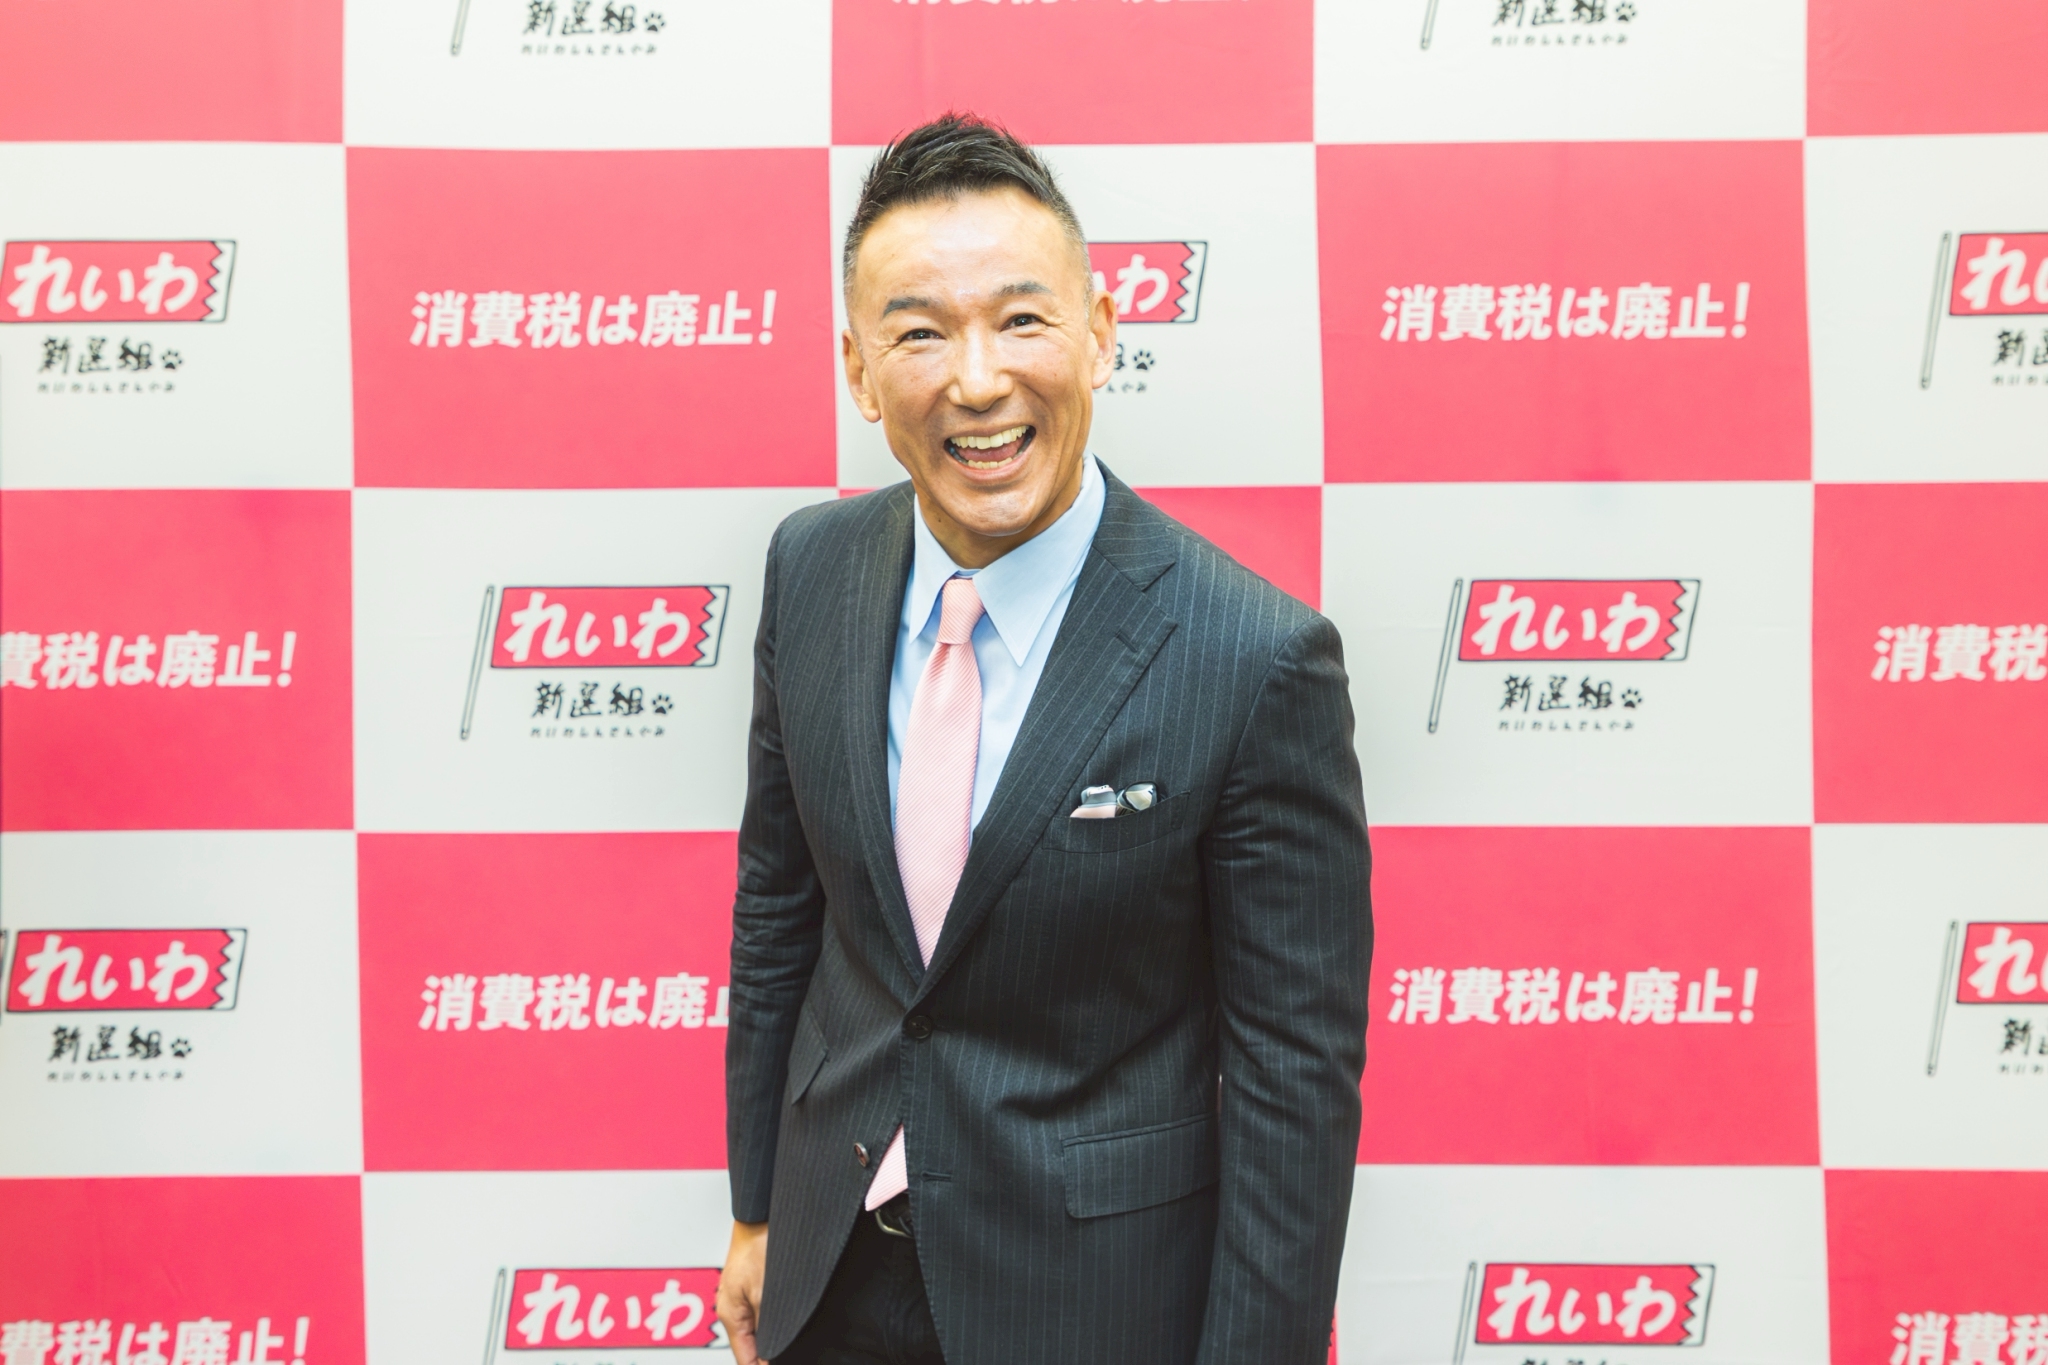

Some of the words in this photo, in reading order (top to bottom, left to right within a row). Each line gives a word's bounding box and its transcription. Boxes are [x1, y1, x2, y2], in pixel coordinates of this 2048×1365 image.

[7, 245, 198, 318] れいわ
[1380, 282, 1750, 342] 消費税は廃止!
[410, 289, 777, 349] 消費税は廃止!
[502, 591, 690, 664] れいわ
[1470, 585, 1661, 655] れいわ
[1871, 623, 2048, 682] 消費税
[17, 934, 209, 1006] れいわ
[1388, 966, 1758, 1025] 消費税は廃止!
[516, 1272, 705, 1345] れいわ
[1486, 1268, 1677, 1340] れいわ
[1889, 1311, 2048, 1365] 消費税
